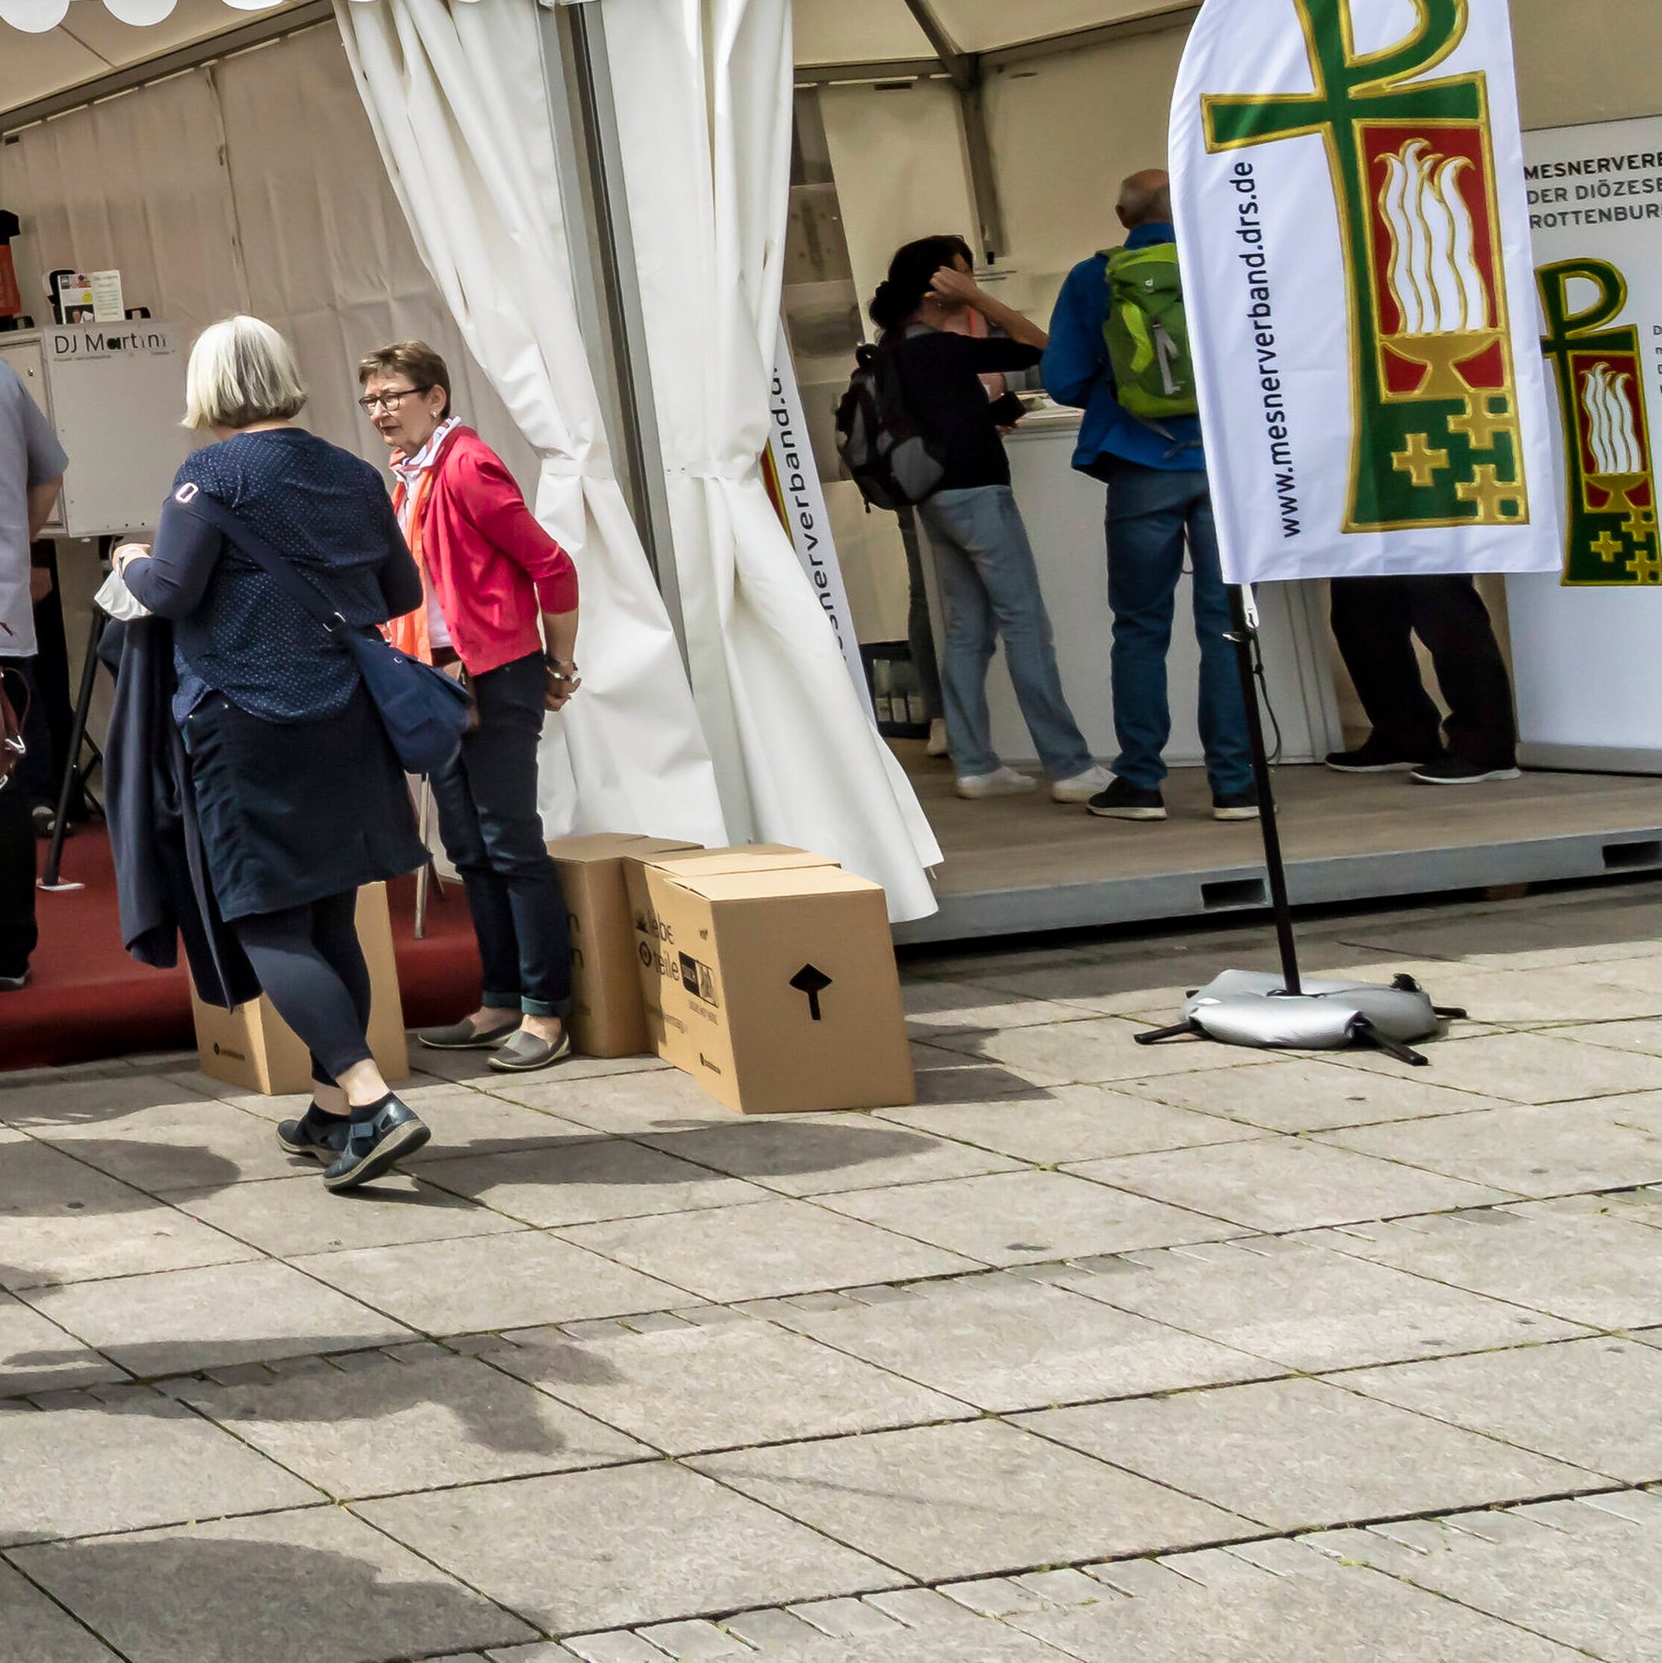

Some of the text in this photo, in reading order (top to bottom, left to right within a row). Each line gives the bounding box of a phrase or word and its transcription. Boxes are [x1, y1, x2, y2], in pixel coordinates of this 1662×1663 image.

[1527, 187, 1568, 205] DER
[1529, 203, 1662, 229] ROTTENBUR
[55, 335, 77, 354] DJ
[1229, 161, 1302, 538] www.mesnerverband.drs.de
